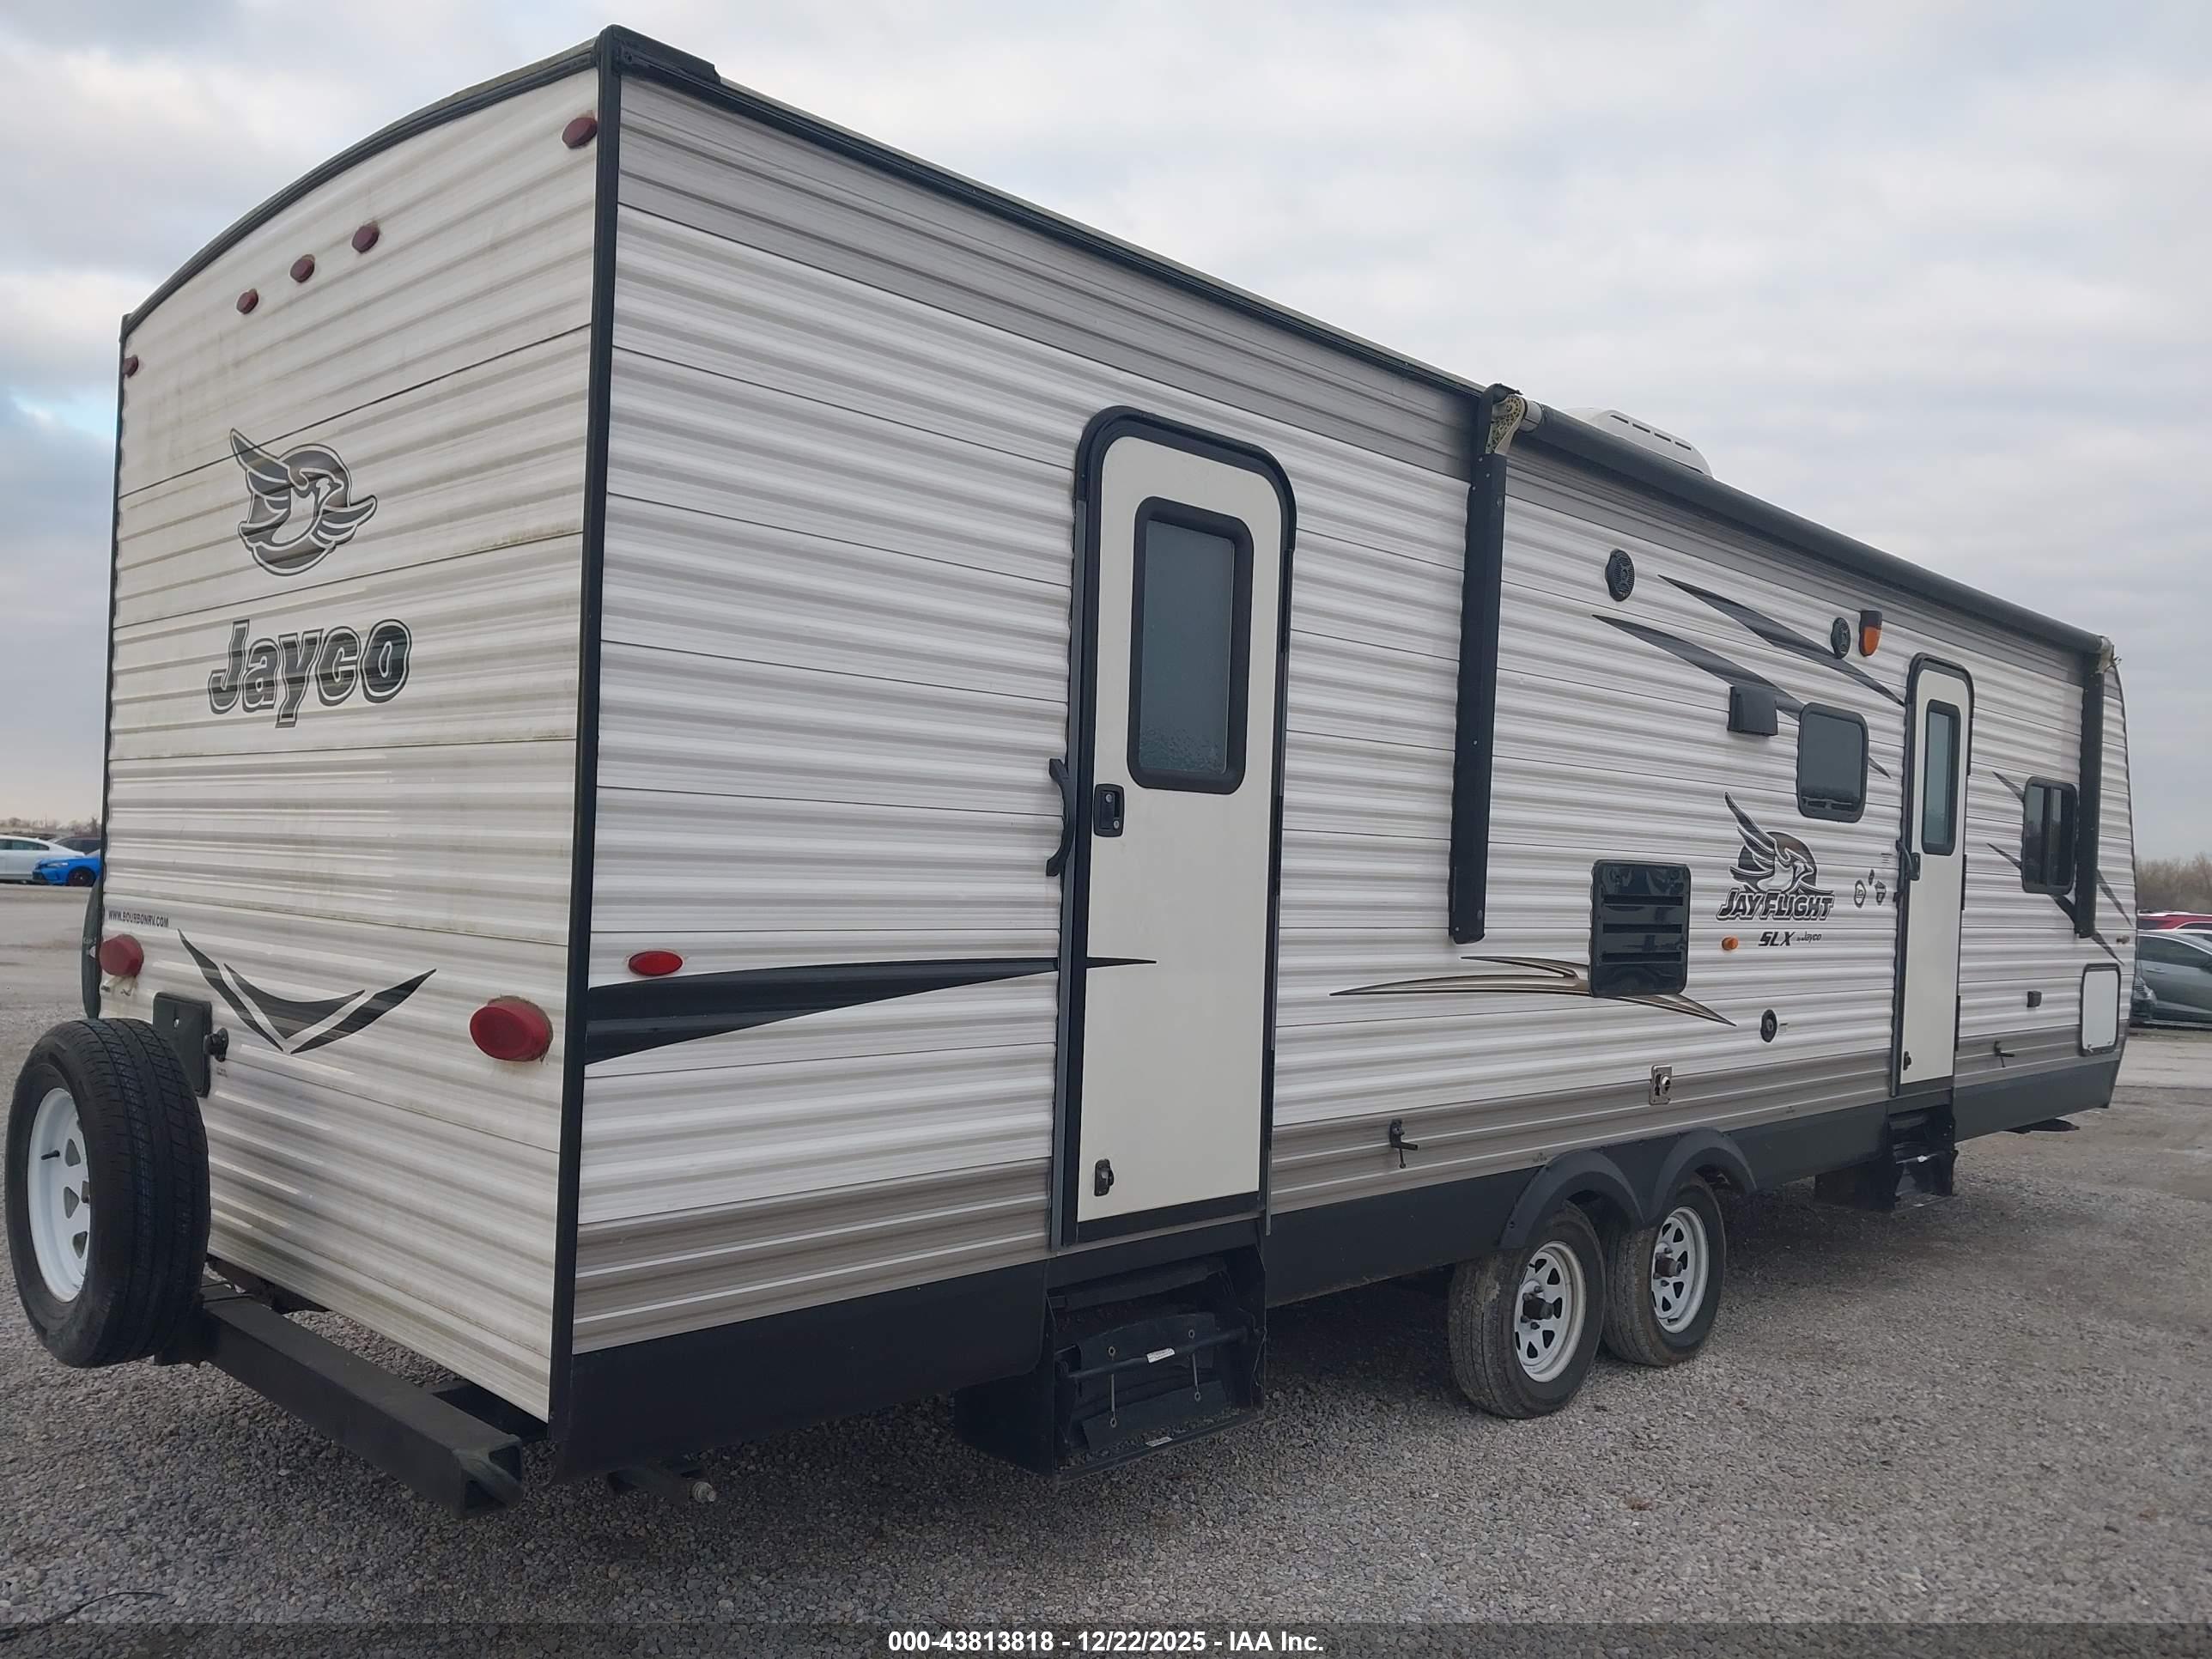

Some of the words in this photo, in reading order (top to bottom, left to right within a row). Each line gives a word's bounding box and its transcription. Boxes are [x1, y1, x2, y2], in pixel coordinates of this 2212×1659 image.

[208, 618, 411, 728] Jayco
[1717, 888, 1764, 921] JAY
[1760, 889, 1835, 921] FLIGHT
[1759, 931, 1795, 946] SLX
